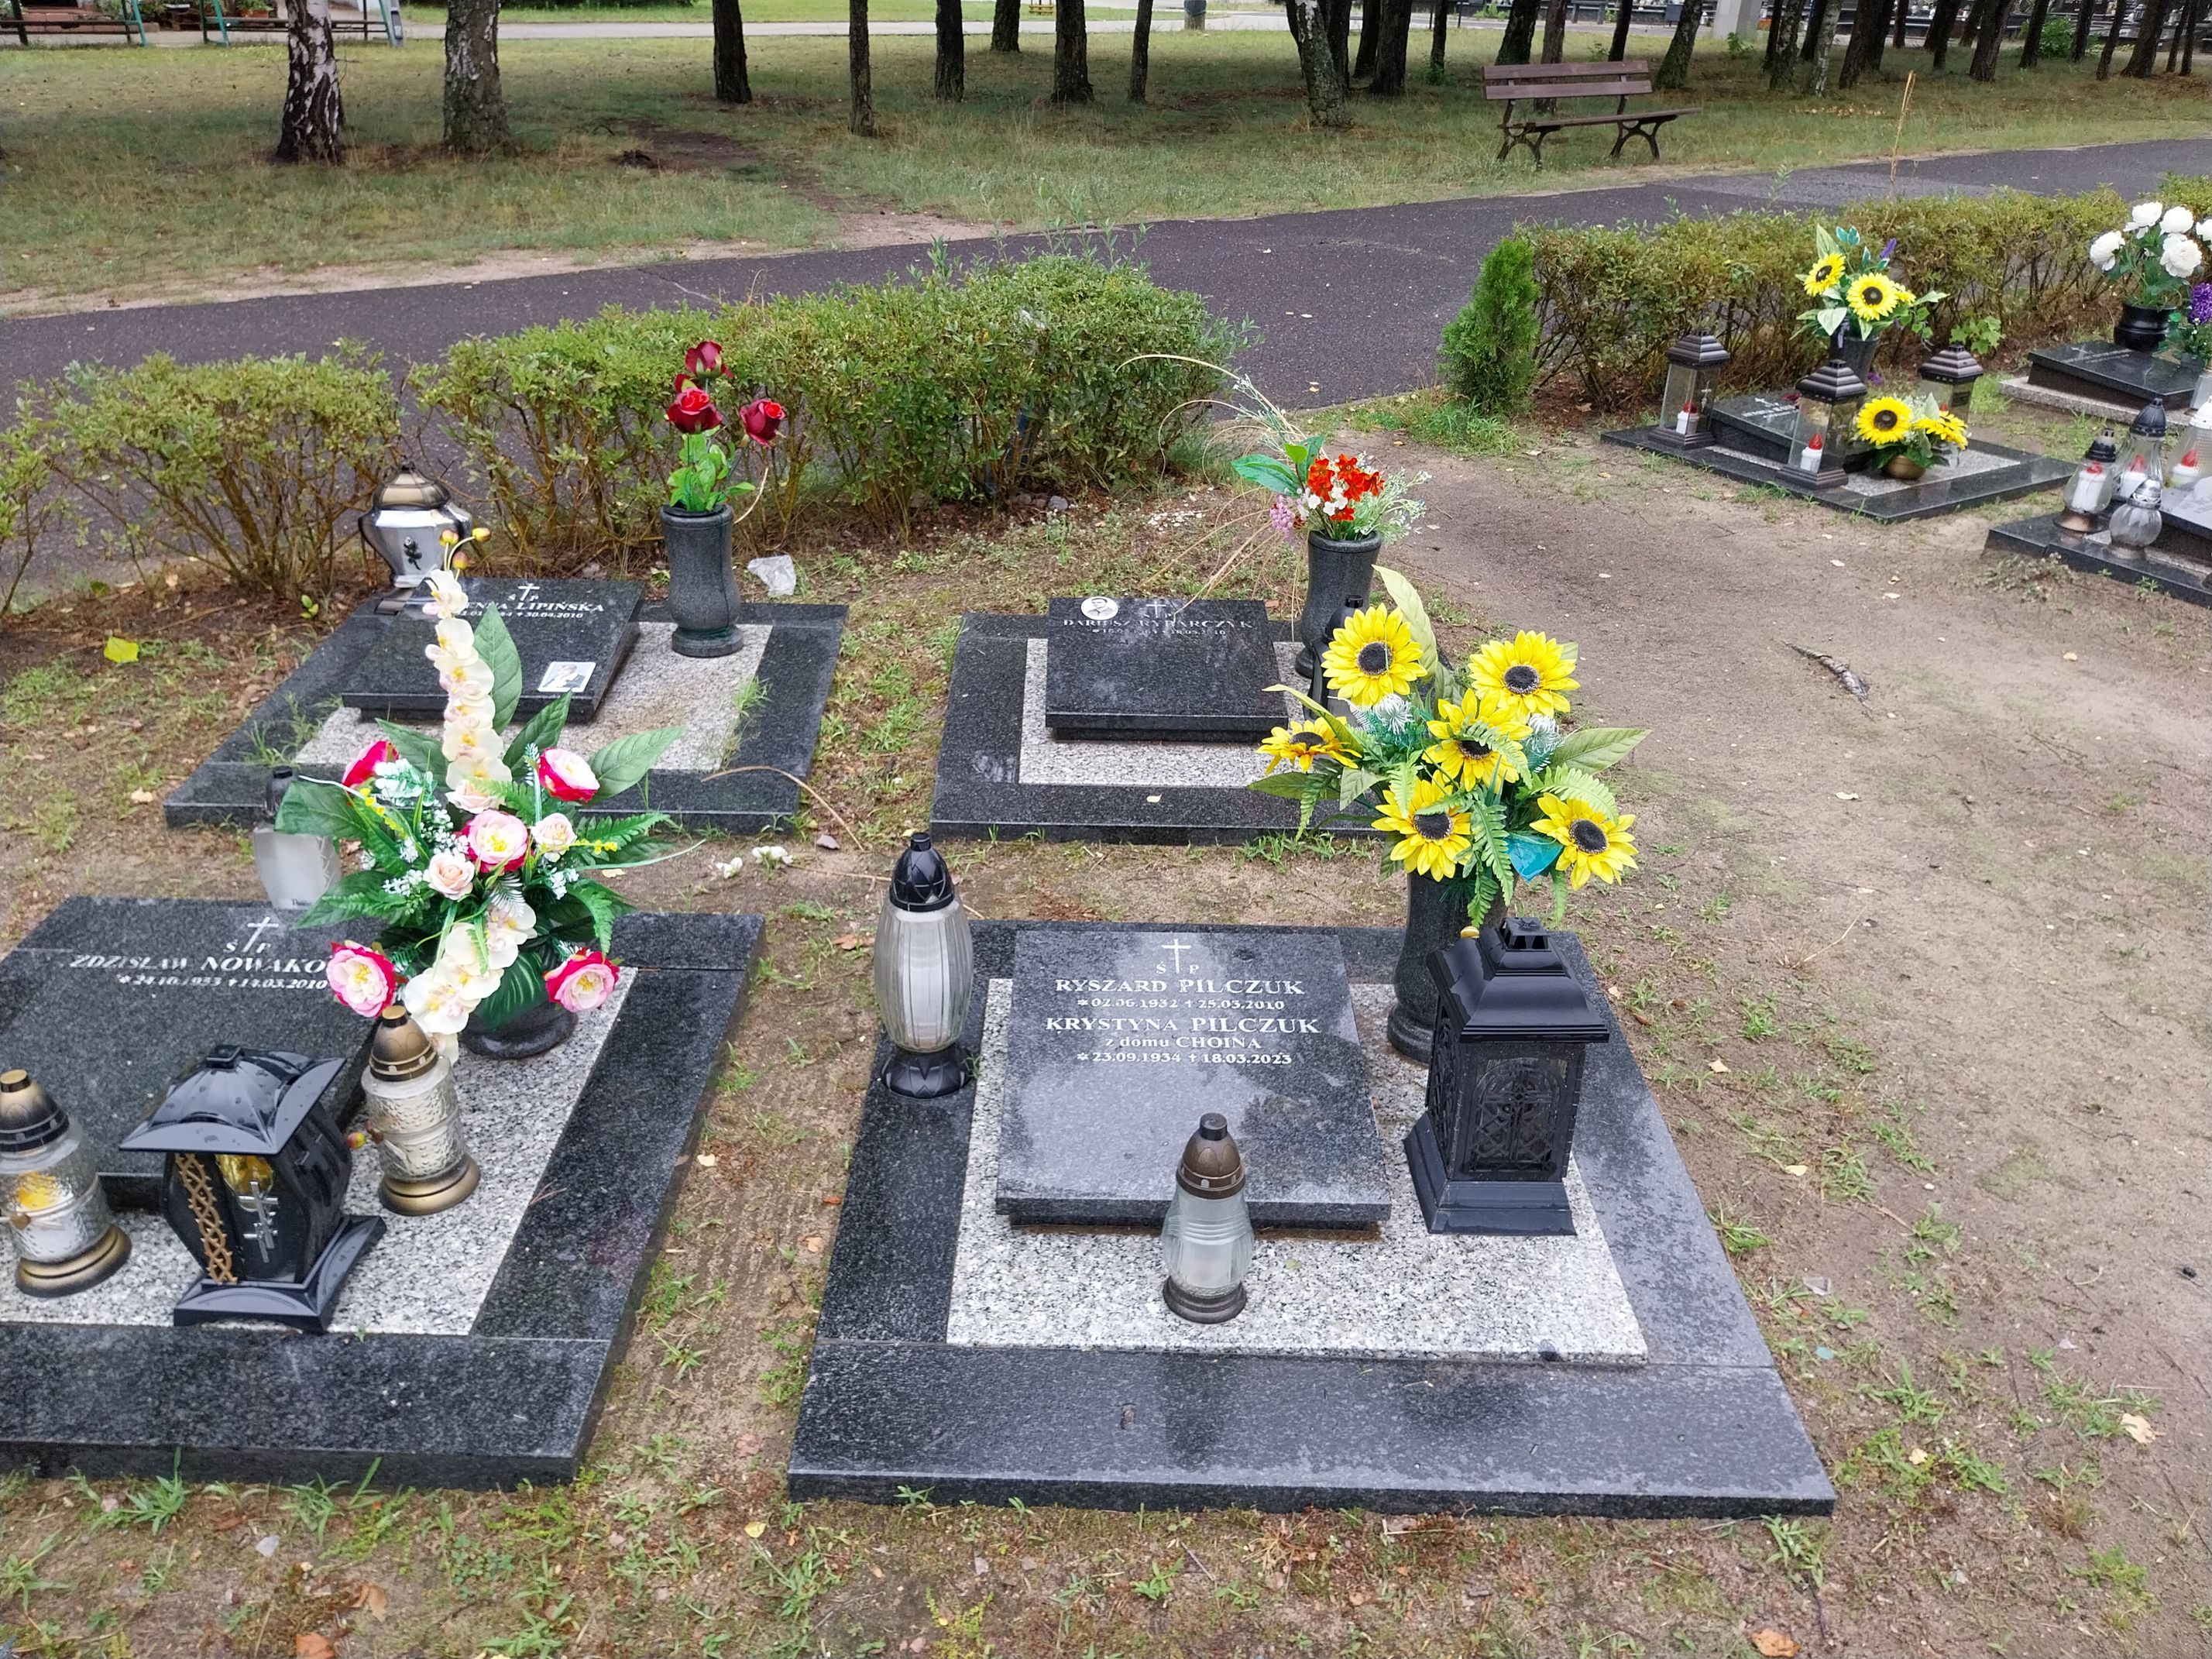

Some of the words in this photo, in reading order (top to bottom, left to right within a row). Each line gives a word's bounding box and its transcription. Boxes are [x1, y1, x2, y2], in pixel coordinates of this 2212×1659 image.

[201, 956, 326, 974] NOWAKO
[1156, 960, 1166, 974] Ś
[1189, 963, 1200, 974] P
[1055, 979, 1167, 993] RYSZARD
[1179, 979, 1306, 995] PILCZUK
[1046, 1017, 1178, 1032] KRYSTYNA
[1190, 1017, 1321, 1034] PILCZUK
[1104, 1039, 1115, 1048] z
[1120, 1036, 1170, 1048] domu
[1176, 1036, 1262, 1049] CHOINA
